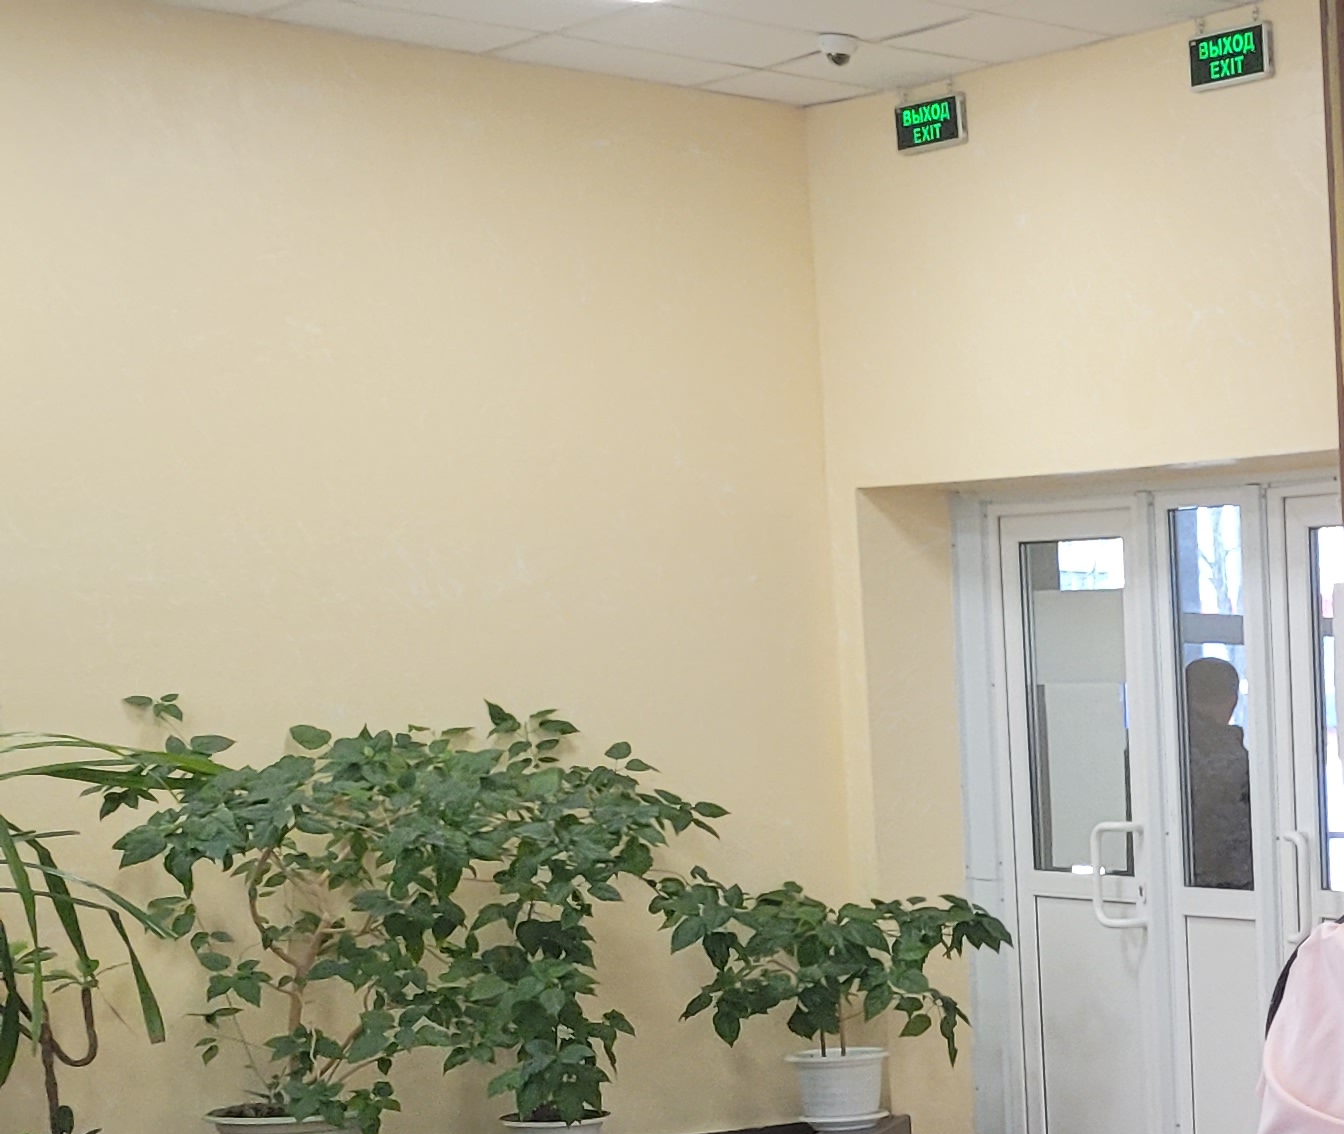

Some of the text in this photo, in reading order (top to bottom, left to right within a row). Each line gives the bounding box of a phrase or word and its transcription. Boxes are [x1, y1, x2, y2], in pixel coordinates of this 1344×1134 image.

[1199, 32, 1254, 59] ВЫХОД
[1210, 55, 1244, 79] EXIT
[903, 101, 950, 126] ВЫХОД
[913, 123, 942, 143] EXIT
